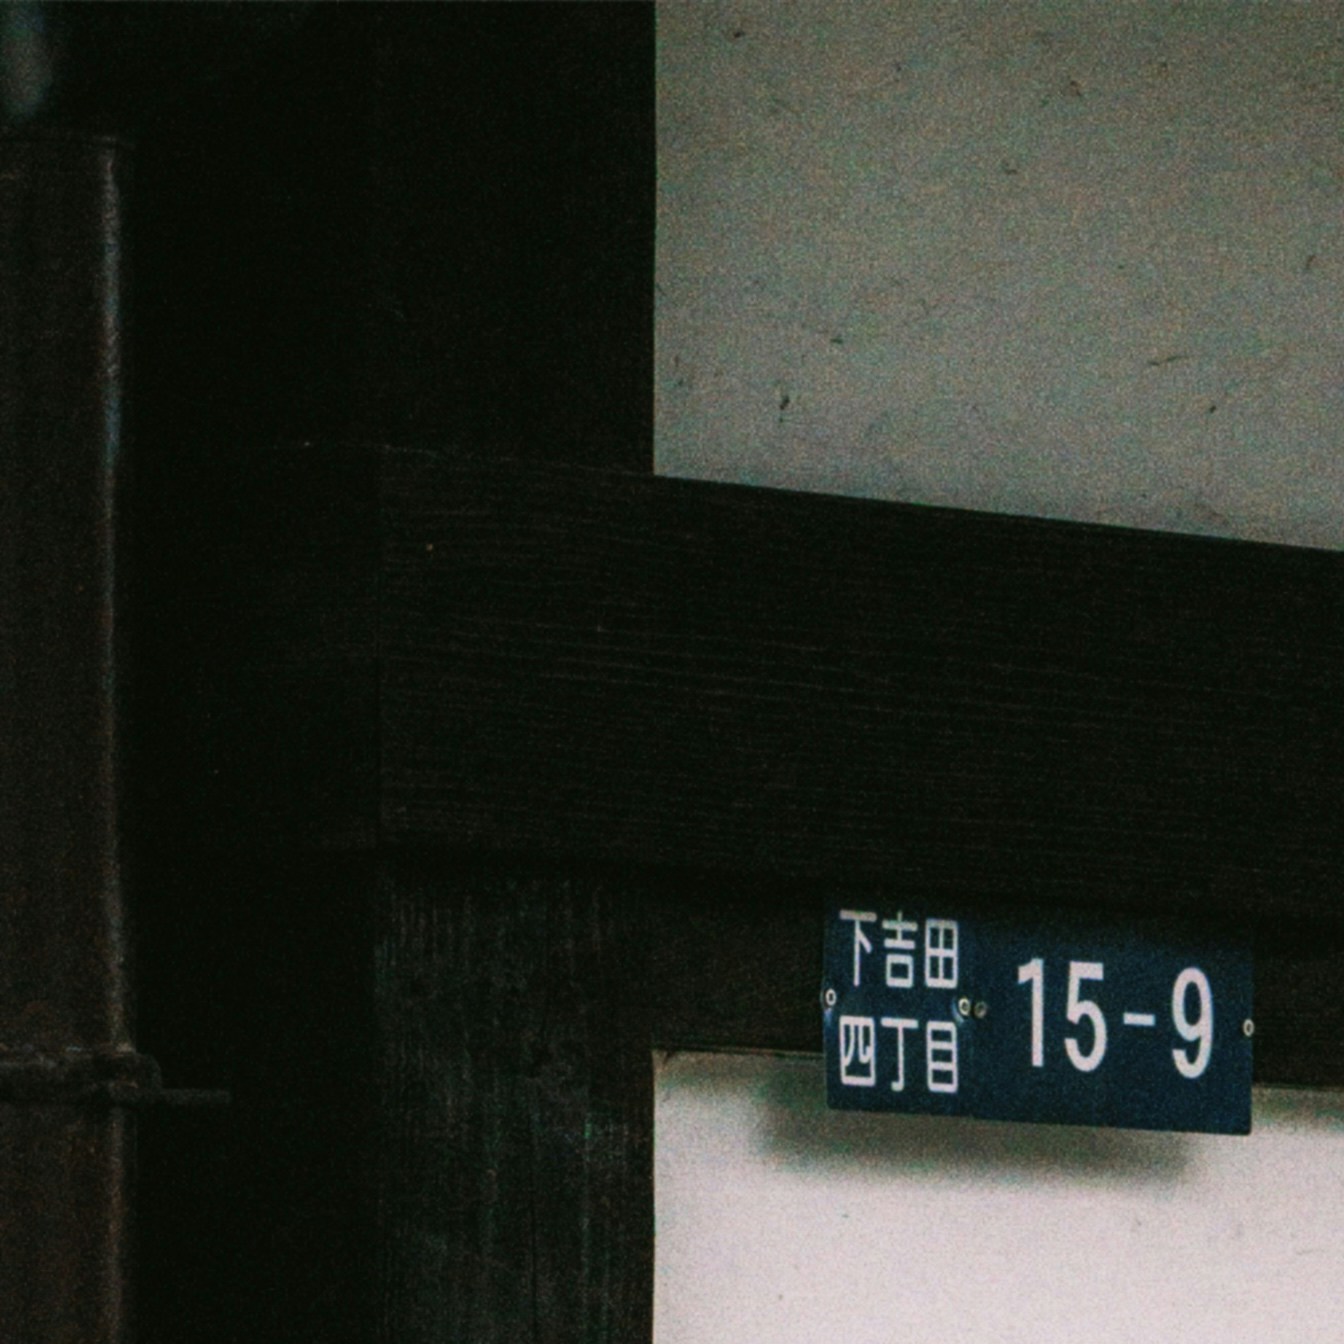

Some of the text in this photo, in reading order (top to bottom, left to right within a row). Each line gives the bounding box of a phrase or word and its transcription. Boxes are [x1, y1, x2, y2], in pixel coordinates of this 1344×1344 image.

[839, 910, 959, 989] 下吉田
[839, 1015, 959, 1093] 四丁目
[1017, 957, 1214, 1079] 15-9
